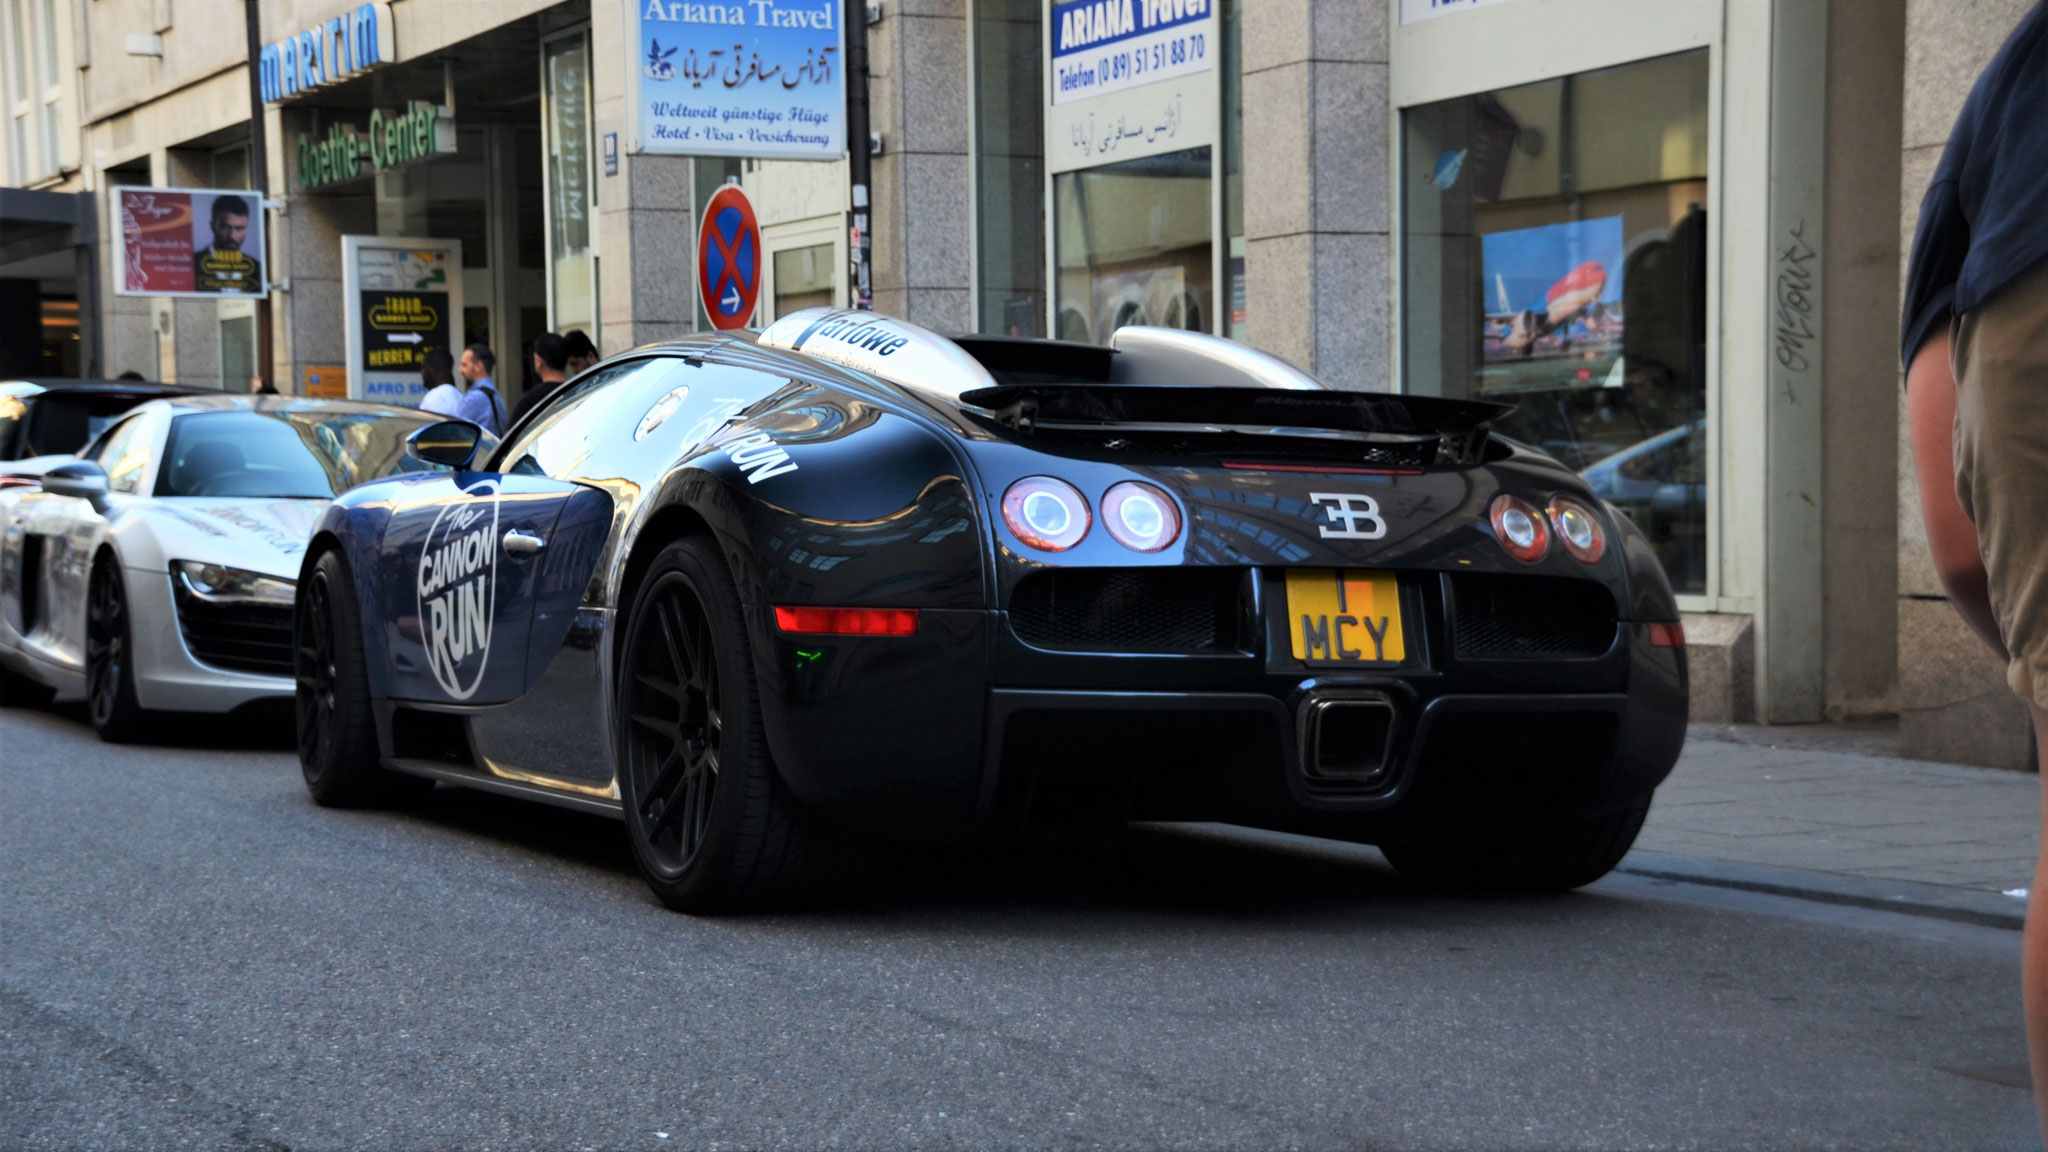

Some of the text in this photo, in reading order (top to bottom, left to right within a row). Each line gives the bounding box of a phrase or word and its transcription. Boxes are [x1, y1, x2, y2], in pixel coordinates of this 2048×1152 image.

[644, 0, 834, 30] Ariana Travel
[1060, 0, 1135, 50] ARIANA
[259, 2, 379, 103] MARITIM
[782, 46, 838, 89] آژانس
[1059, 33, 1205, 92] Telefon (0 89) 51 51 88 70
[651, 101, 830, 127] Weltweit günstige Flüge
[652, 124, 830, 148] Hotel Visa Versicherung
[298, 100, 438, 188] Goethe-Center
[369, 347, 412, 367] HERREN
[367, 382, 405, 395] AFRO
[720, 432, 799, 485] RUN
[445, 502, 485, 543] The
[420, 523, 496, 597] CANNON
[425, 574, 487, 692] RUN
[1302, 614, 1389, 661] MCY
